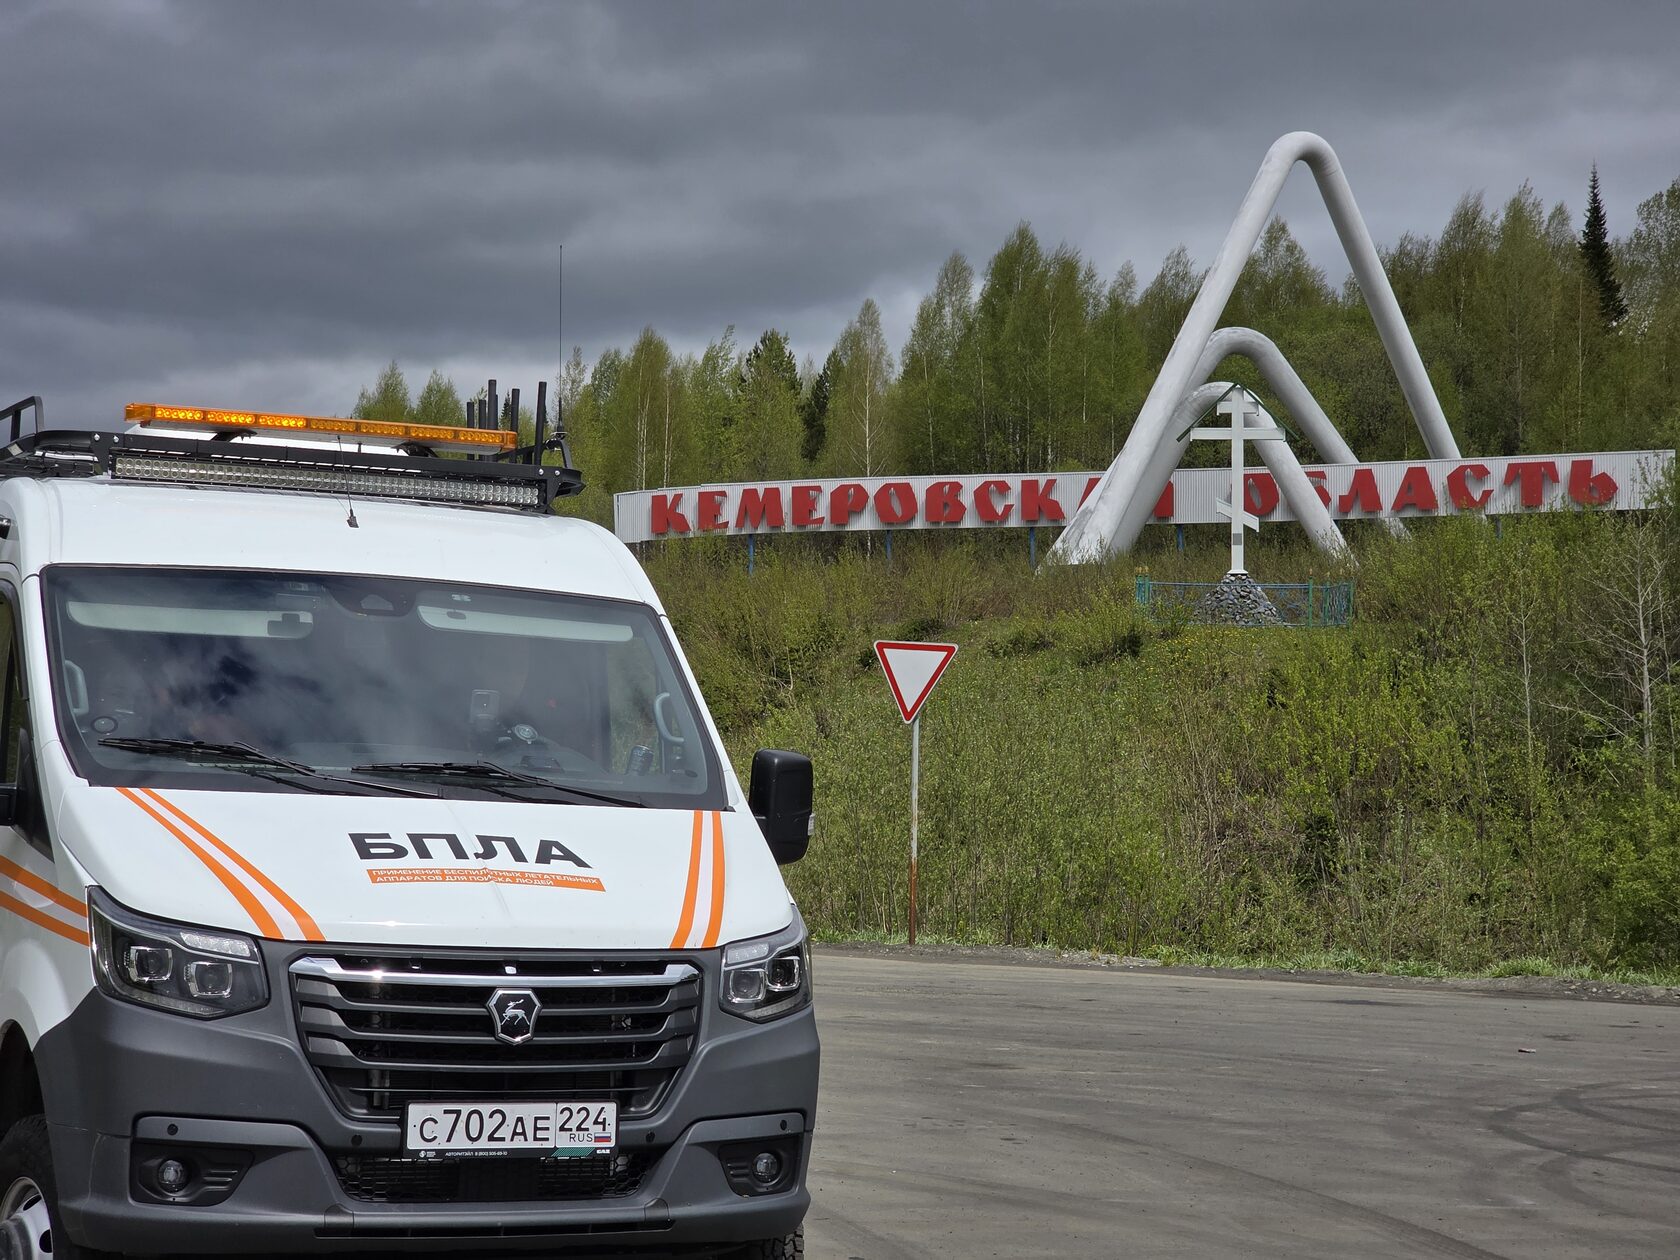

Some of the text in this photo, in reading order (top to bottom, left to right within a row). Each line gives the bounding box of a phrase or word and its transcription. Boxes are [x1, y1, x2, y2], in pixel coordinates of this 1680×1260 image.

[651, 477, 1174, 534] КЕМЕРОВСК
[348, 832, 593, 869] БПЛА
[515, 877, 554, 886] ЛЮДЕЙ
[525, 872, 598, 884] ЛЕТАТЕЛЬНЫХ
[559, 1106, 608, 1132] 224
[569, 1133, 593, 1143] RUS
